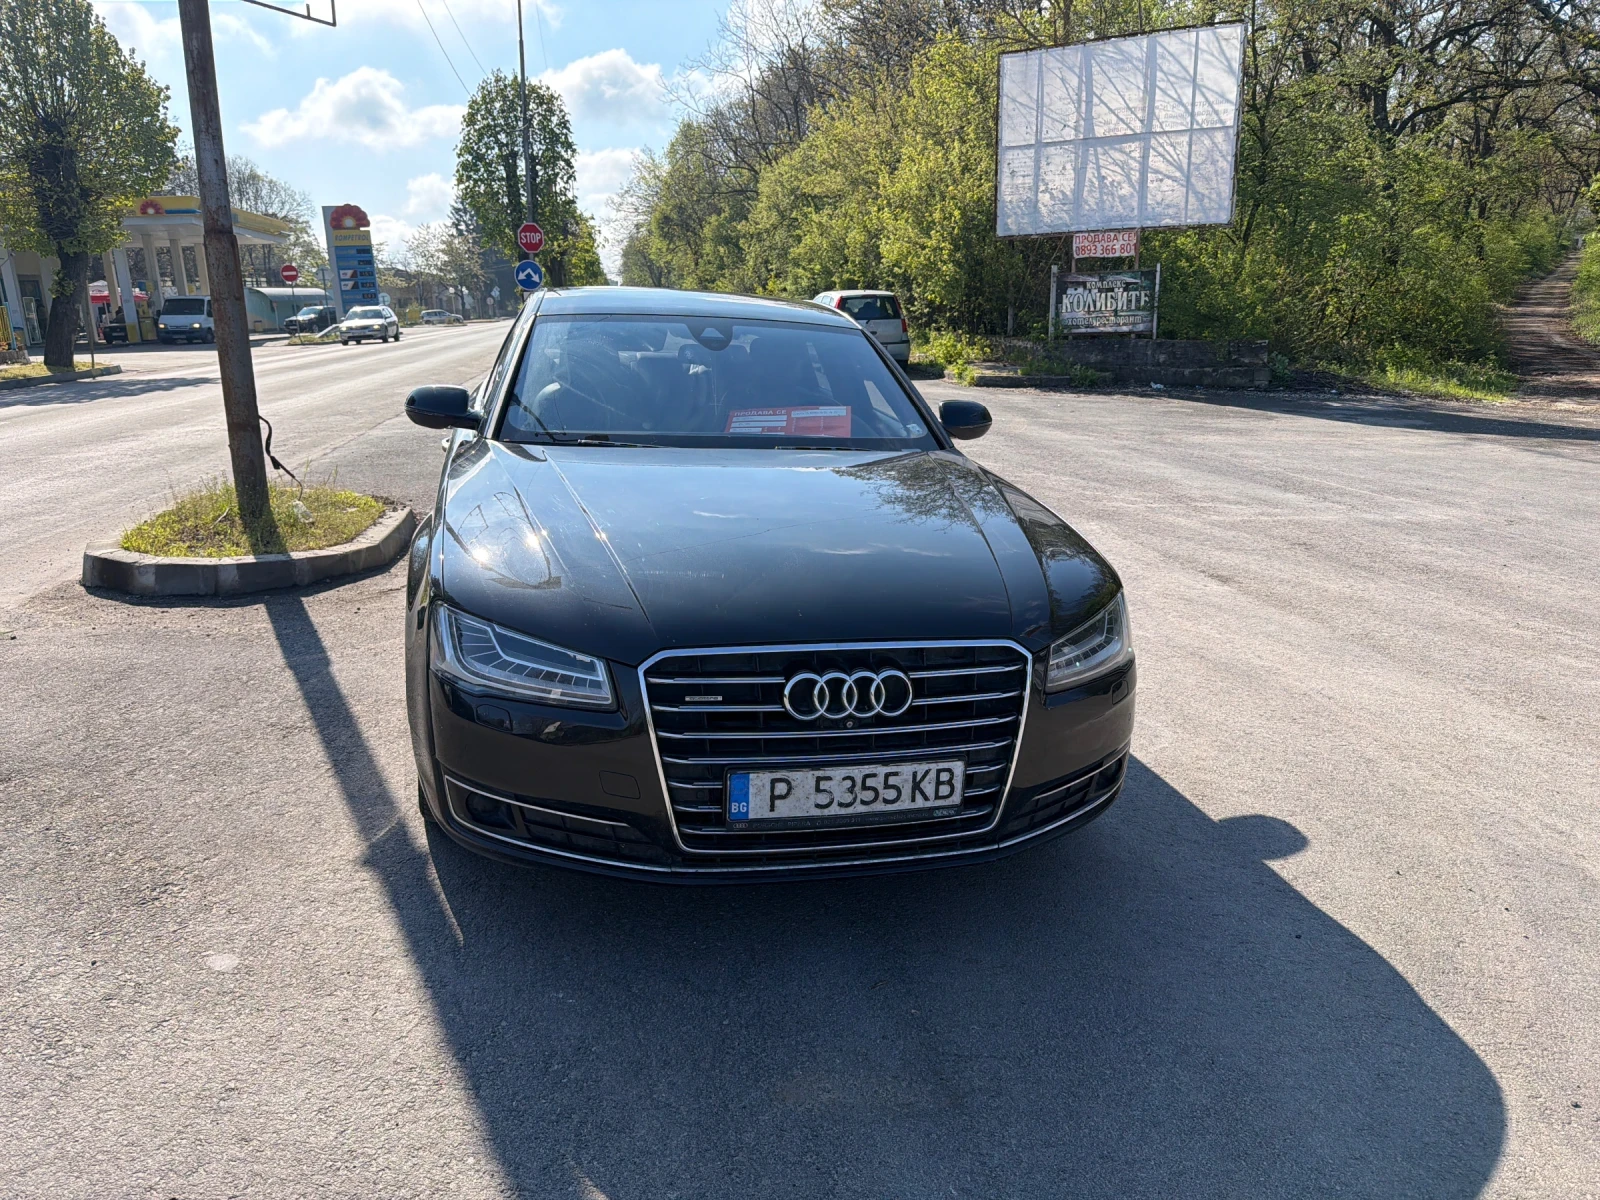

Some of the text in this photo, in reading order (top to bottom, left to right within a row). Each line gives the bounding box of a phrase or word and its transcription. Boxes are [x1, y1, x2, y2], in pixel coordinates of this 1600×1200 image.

[521, 232, 541, 243] STOP
[1075, 233, 1119, 244] ПРОДАВА
[1075, 245, 1097, 256] 0893
[1100, 244, 1117, 255] 366
[769, 777, 793, 812] P
[731, 802, 747, 813] BG
